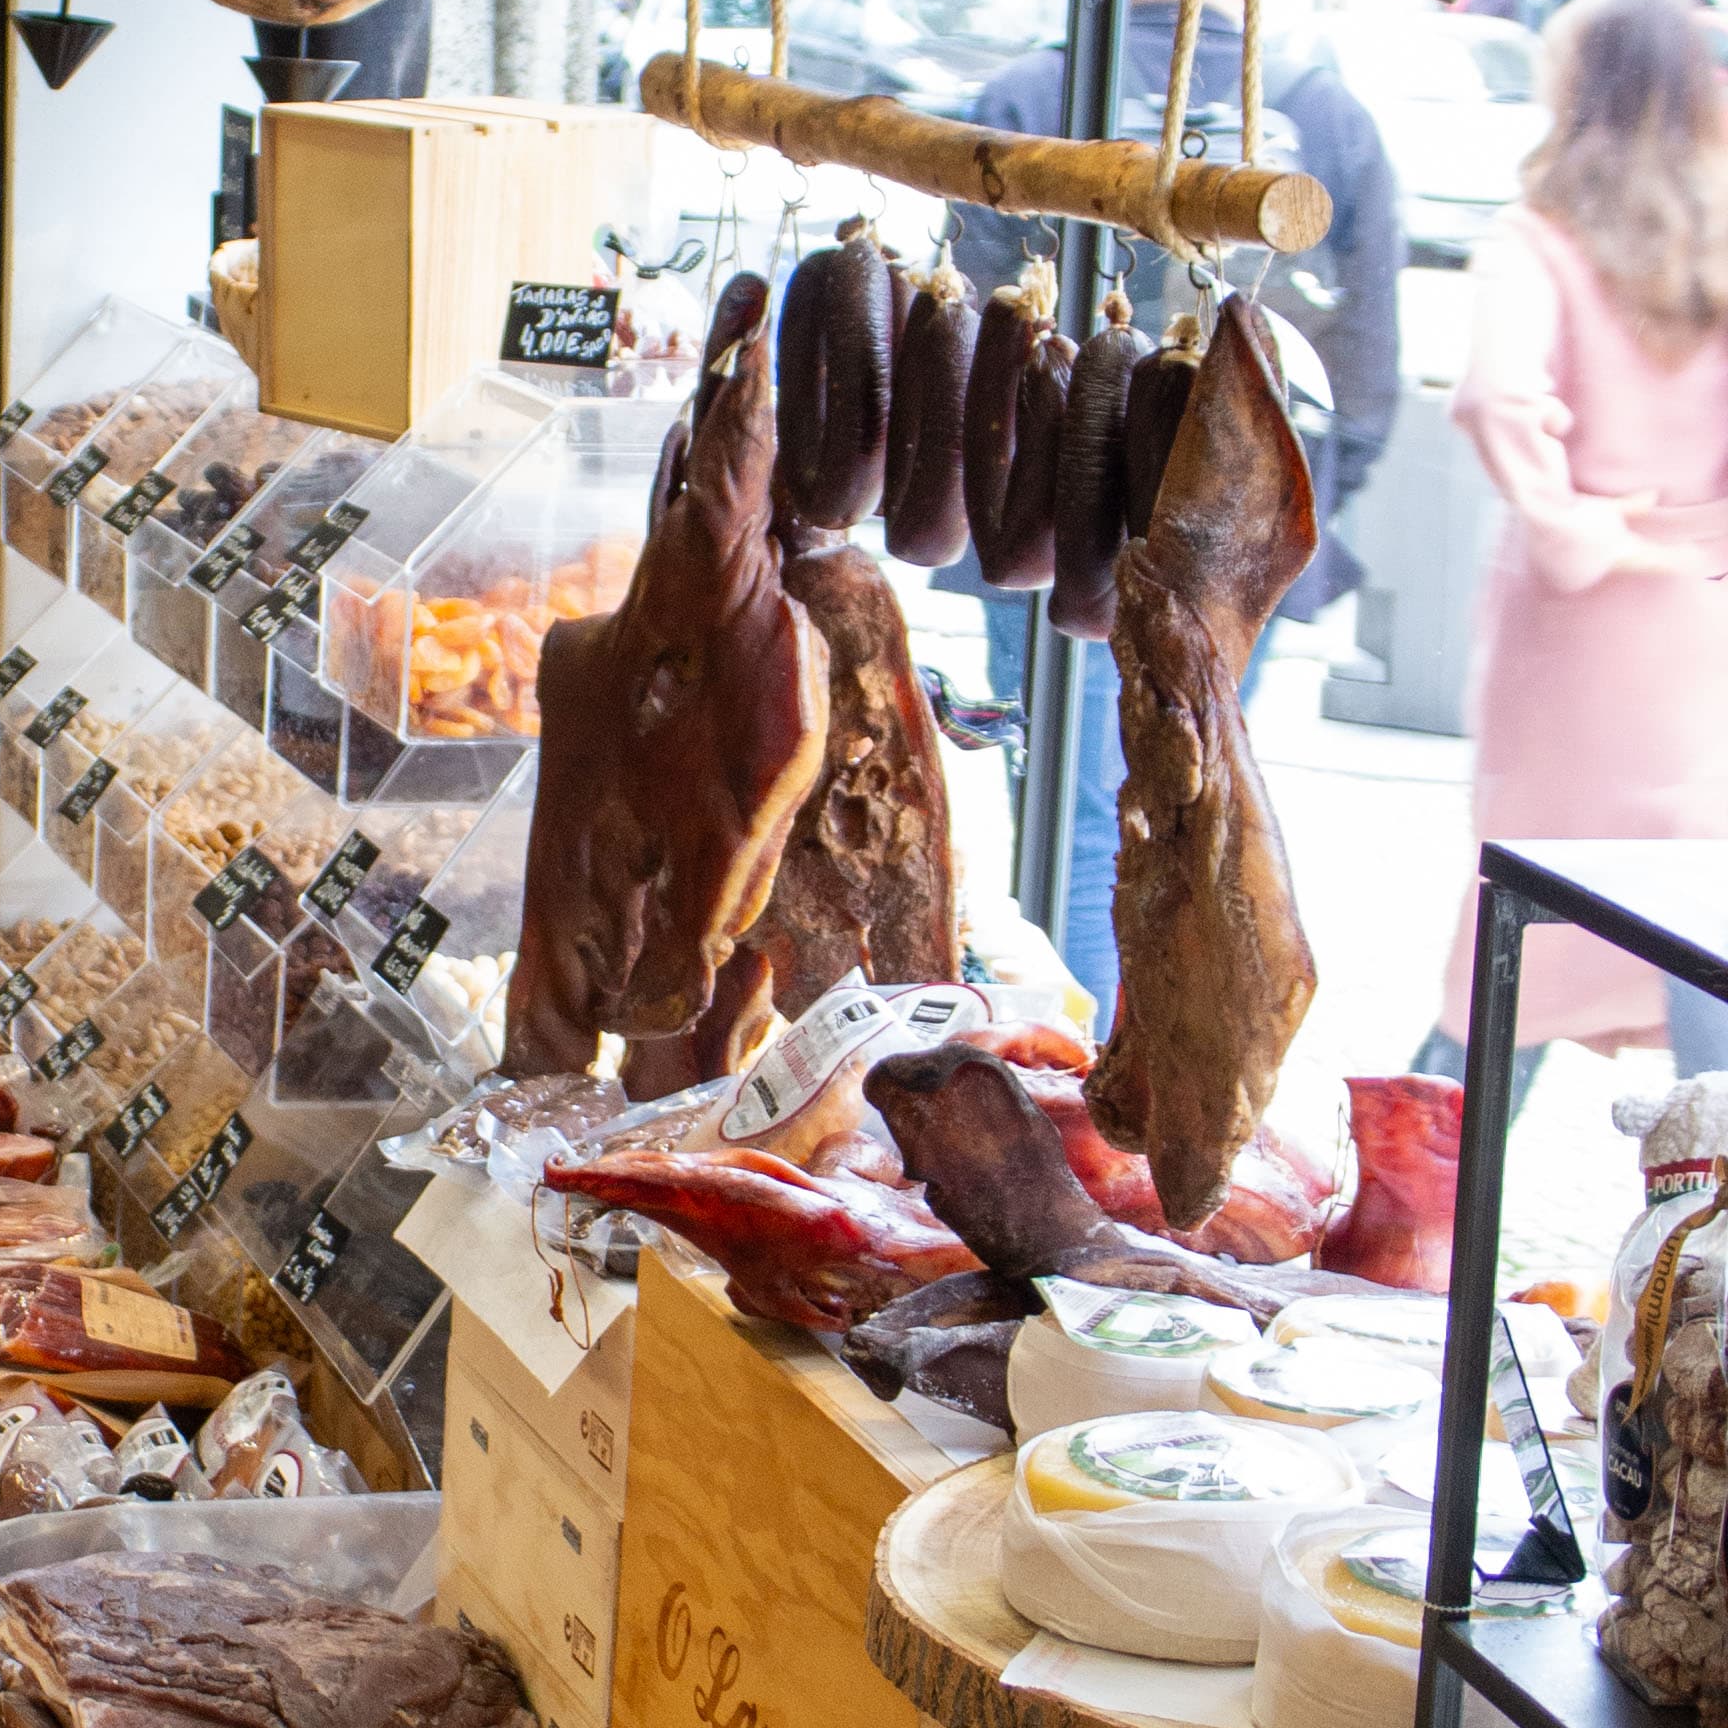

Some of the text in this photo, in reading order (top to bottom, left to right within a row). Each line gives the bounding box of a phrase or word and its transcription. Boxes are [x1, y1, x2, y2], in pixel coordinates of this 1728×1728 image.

[1645, 1235, 1681, 1327] umami
[1607, 1454, 1643, 1490] CACAU
[655, 1580, 694, 1683] O
